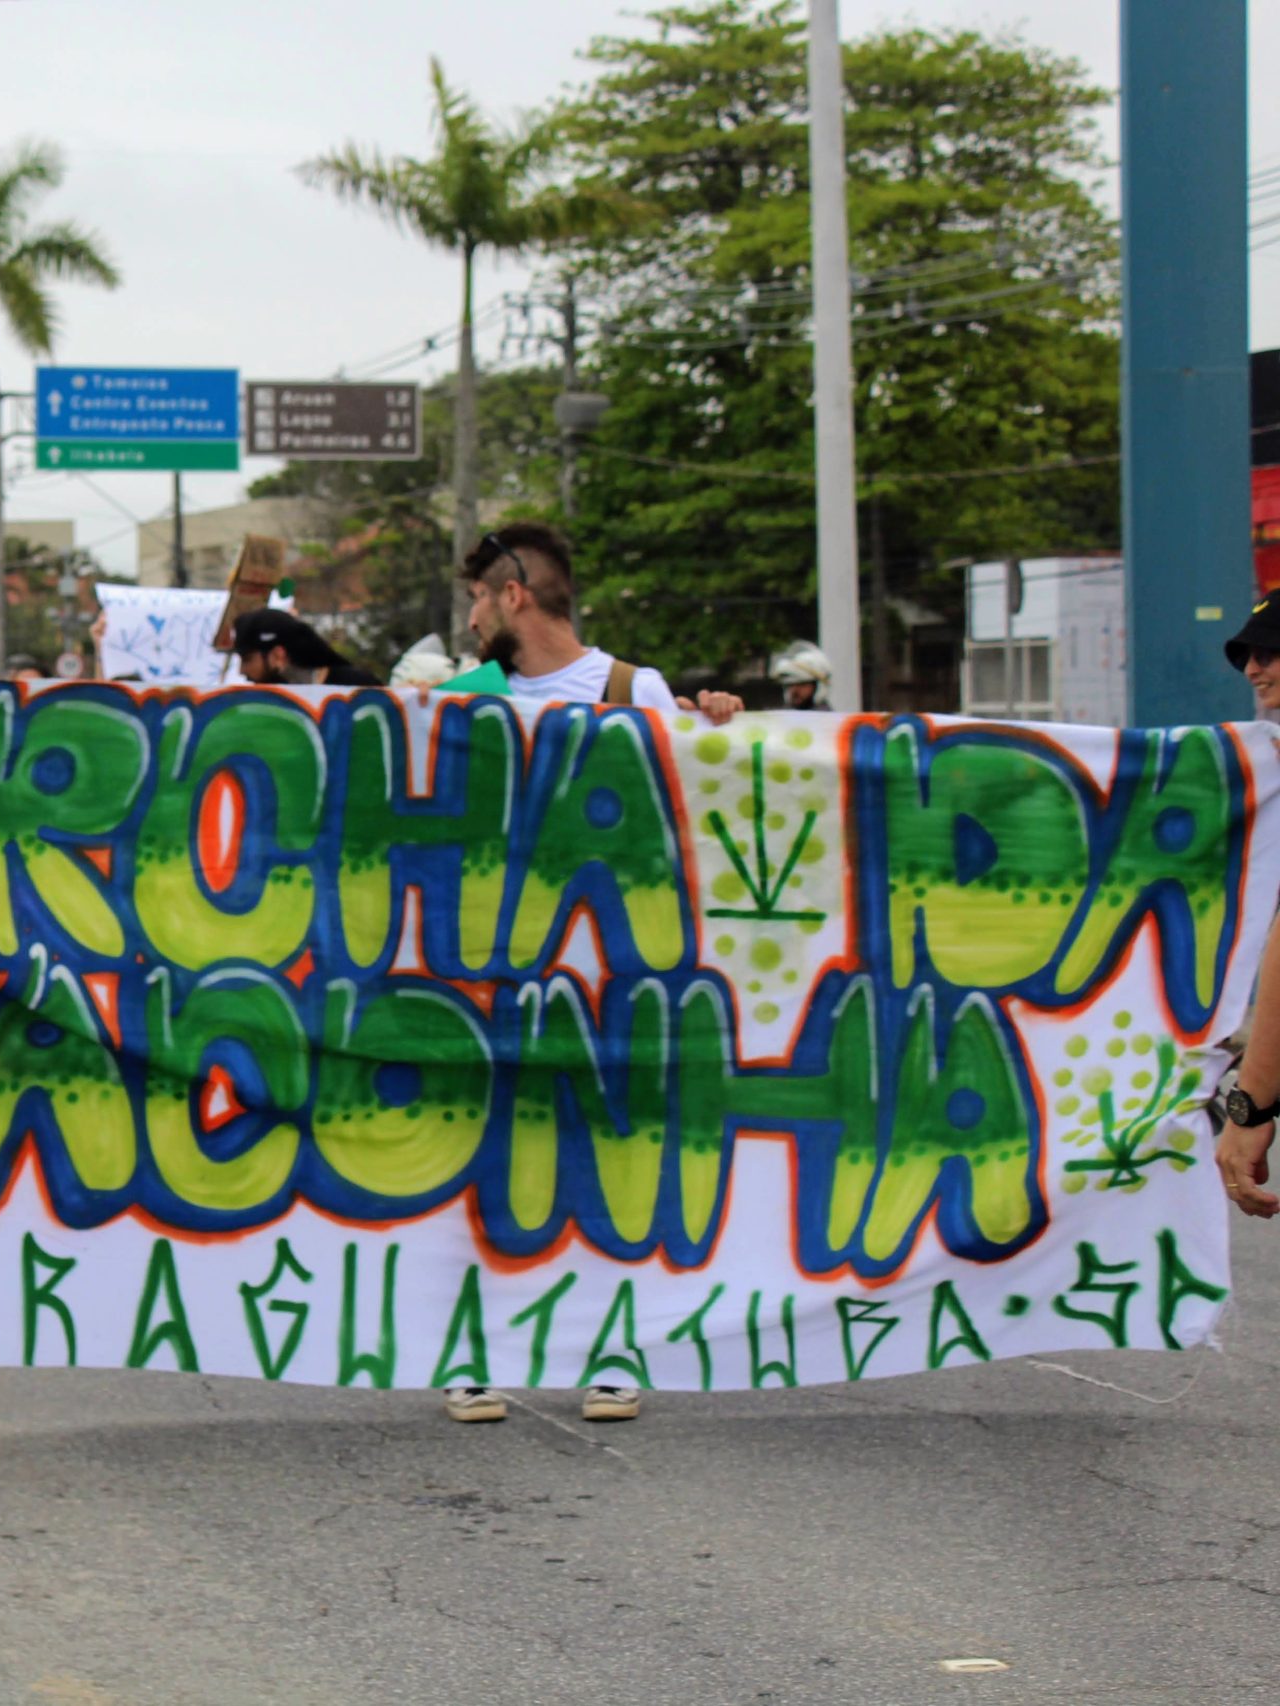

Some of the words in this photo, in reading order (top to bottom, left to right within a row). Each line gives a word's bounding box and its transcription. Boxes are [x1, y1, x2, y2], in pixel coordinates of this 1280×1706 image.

[71, 394, 132, 410] Centro
[135, 395, 210, 411] Eventos
[70, 416, 169, 432] Entreposto
[173, 417, 226, 432] Pesca
[850, 714, 1250, 1034] DA
